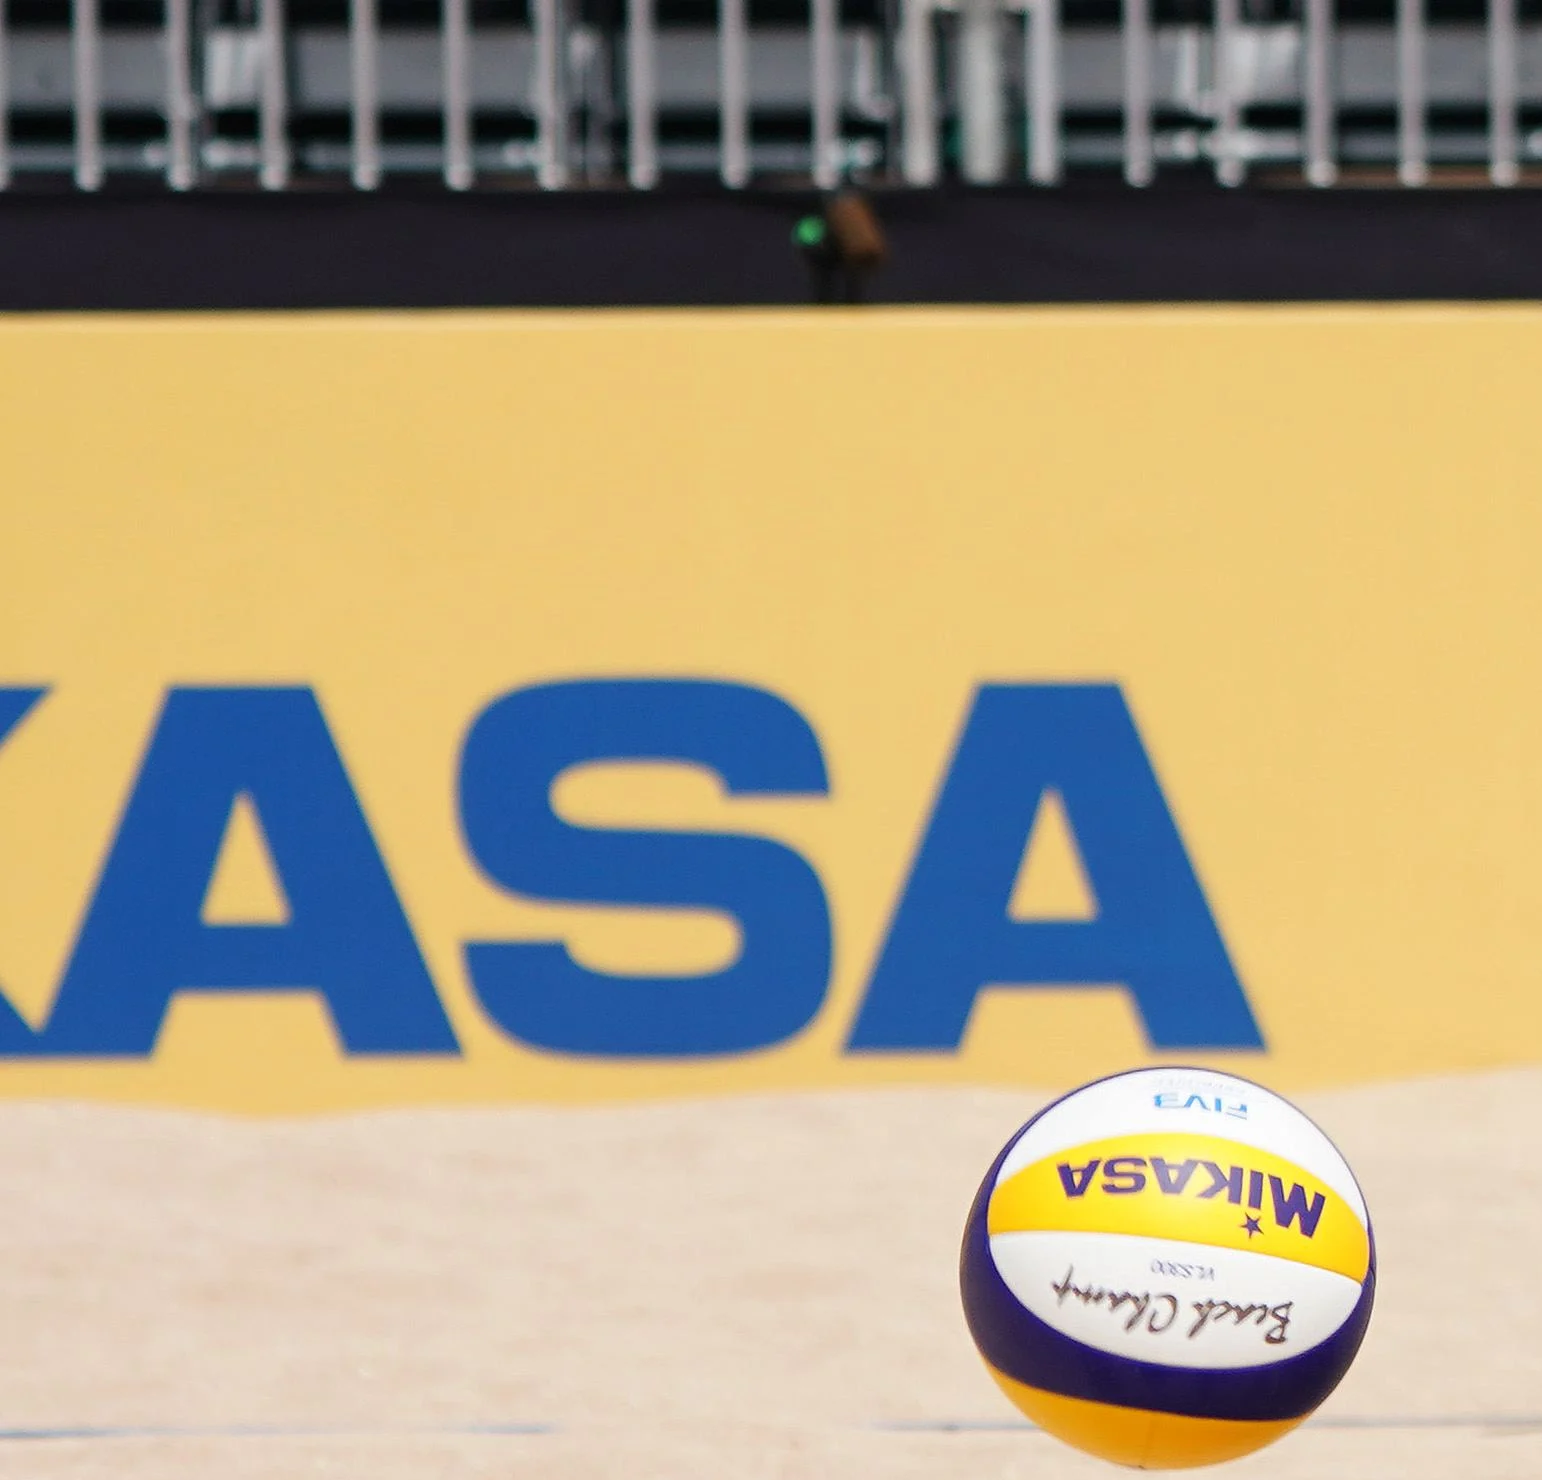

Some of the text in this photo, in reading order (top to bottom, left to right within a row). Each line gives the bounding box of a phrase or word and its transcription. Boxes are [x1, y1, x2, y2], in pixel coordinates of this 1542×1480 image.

[0, 677, 1270, 1059] ASA
[1056, 1155, 1326, 1239] MIKASA
[1051, 1263, 1293, 1345] Beach Champ
